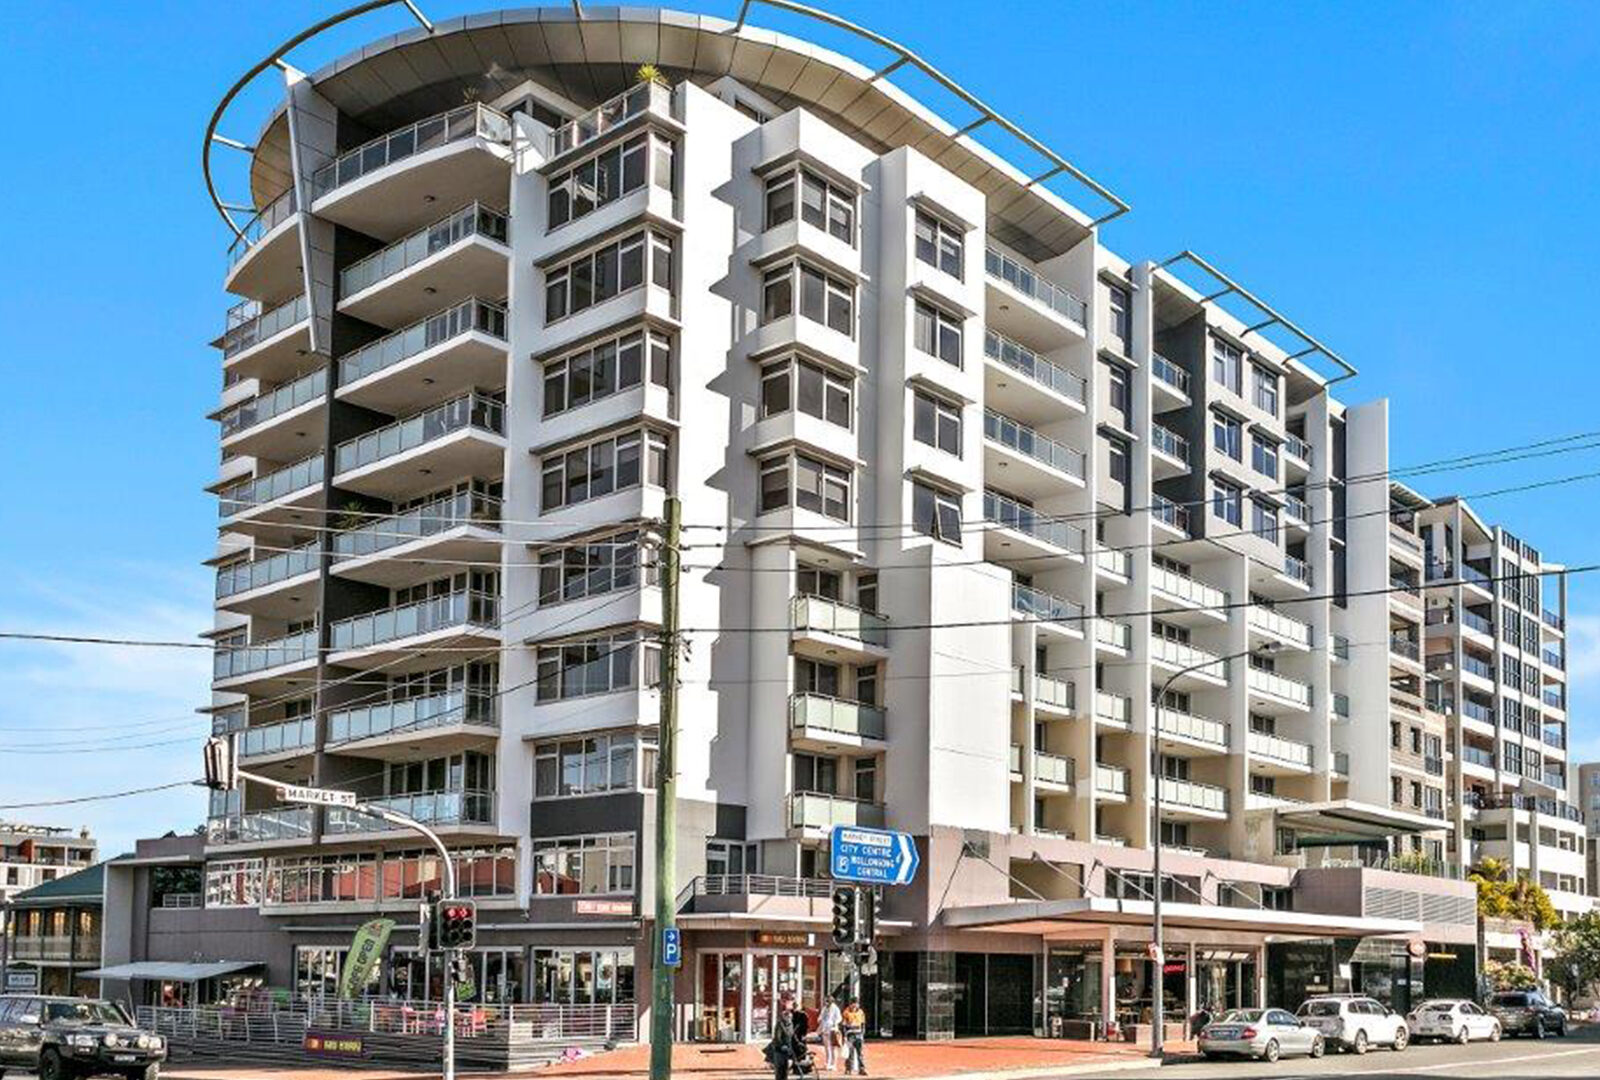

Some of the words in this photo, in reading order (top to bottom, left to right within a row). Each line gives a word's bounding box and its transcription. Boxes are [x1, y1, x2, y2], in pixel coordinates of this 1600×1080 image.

[288, 788, 334, 802] MARKET
[341, 794, 354, 804] ST
[841, 844, 858, 853] CITY
[862, 846, 892, 858] CENTRE
[857, 867, 888, 878] CENTRAL
[357, 938, 375, 964] OPEN
[667, 943, 677, 960] P
